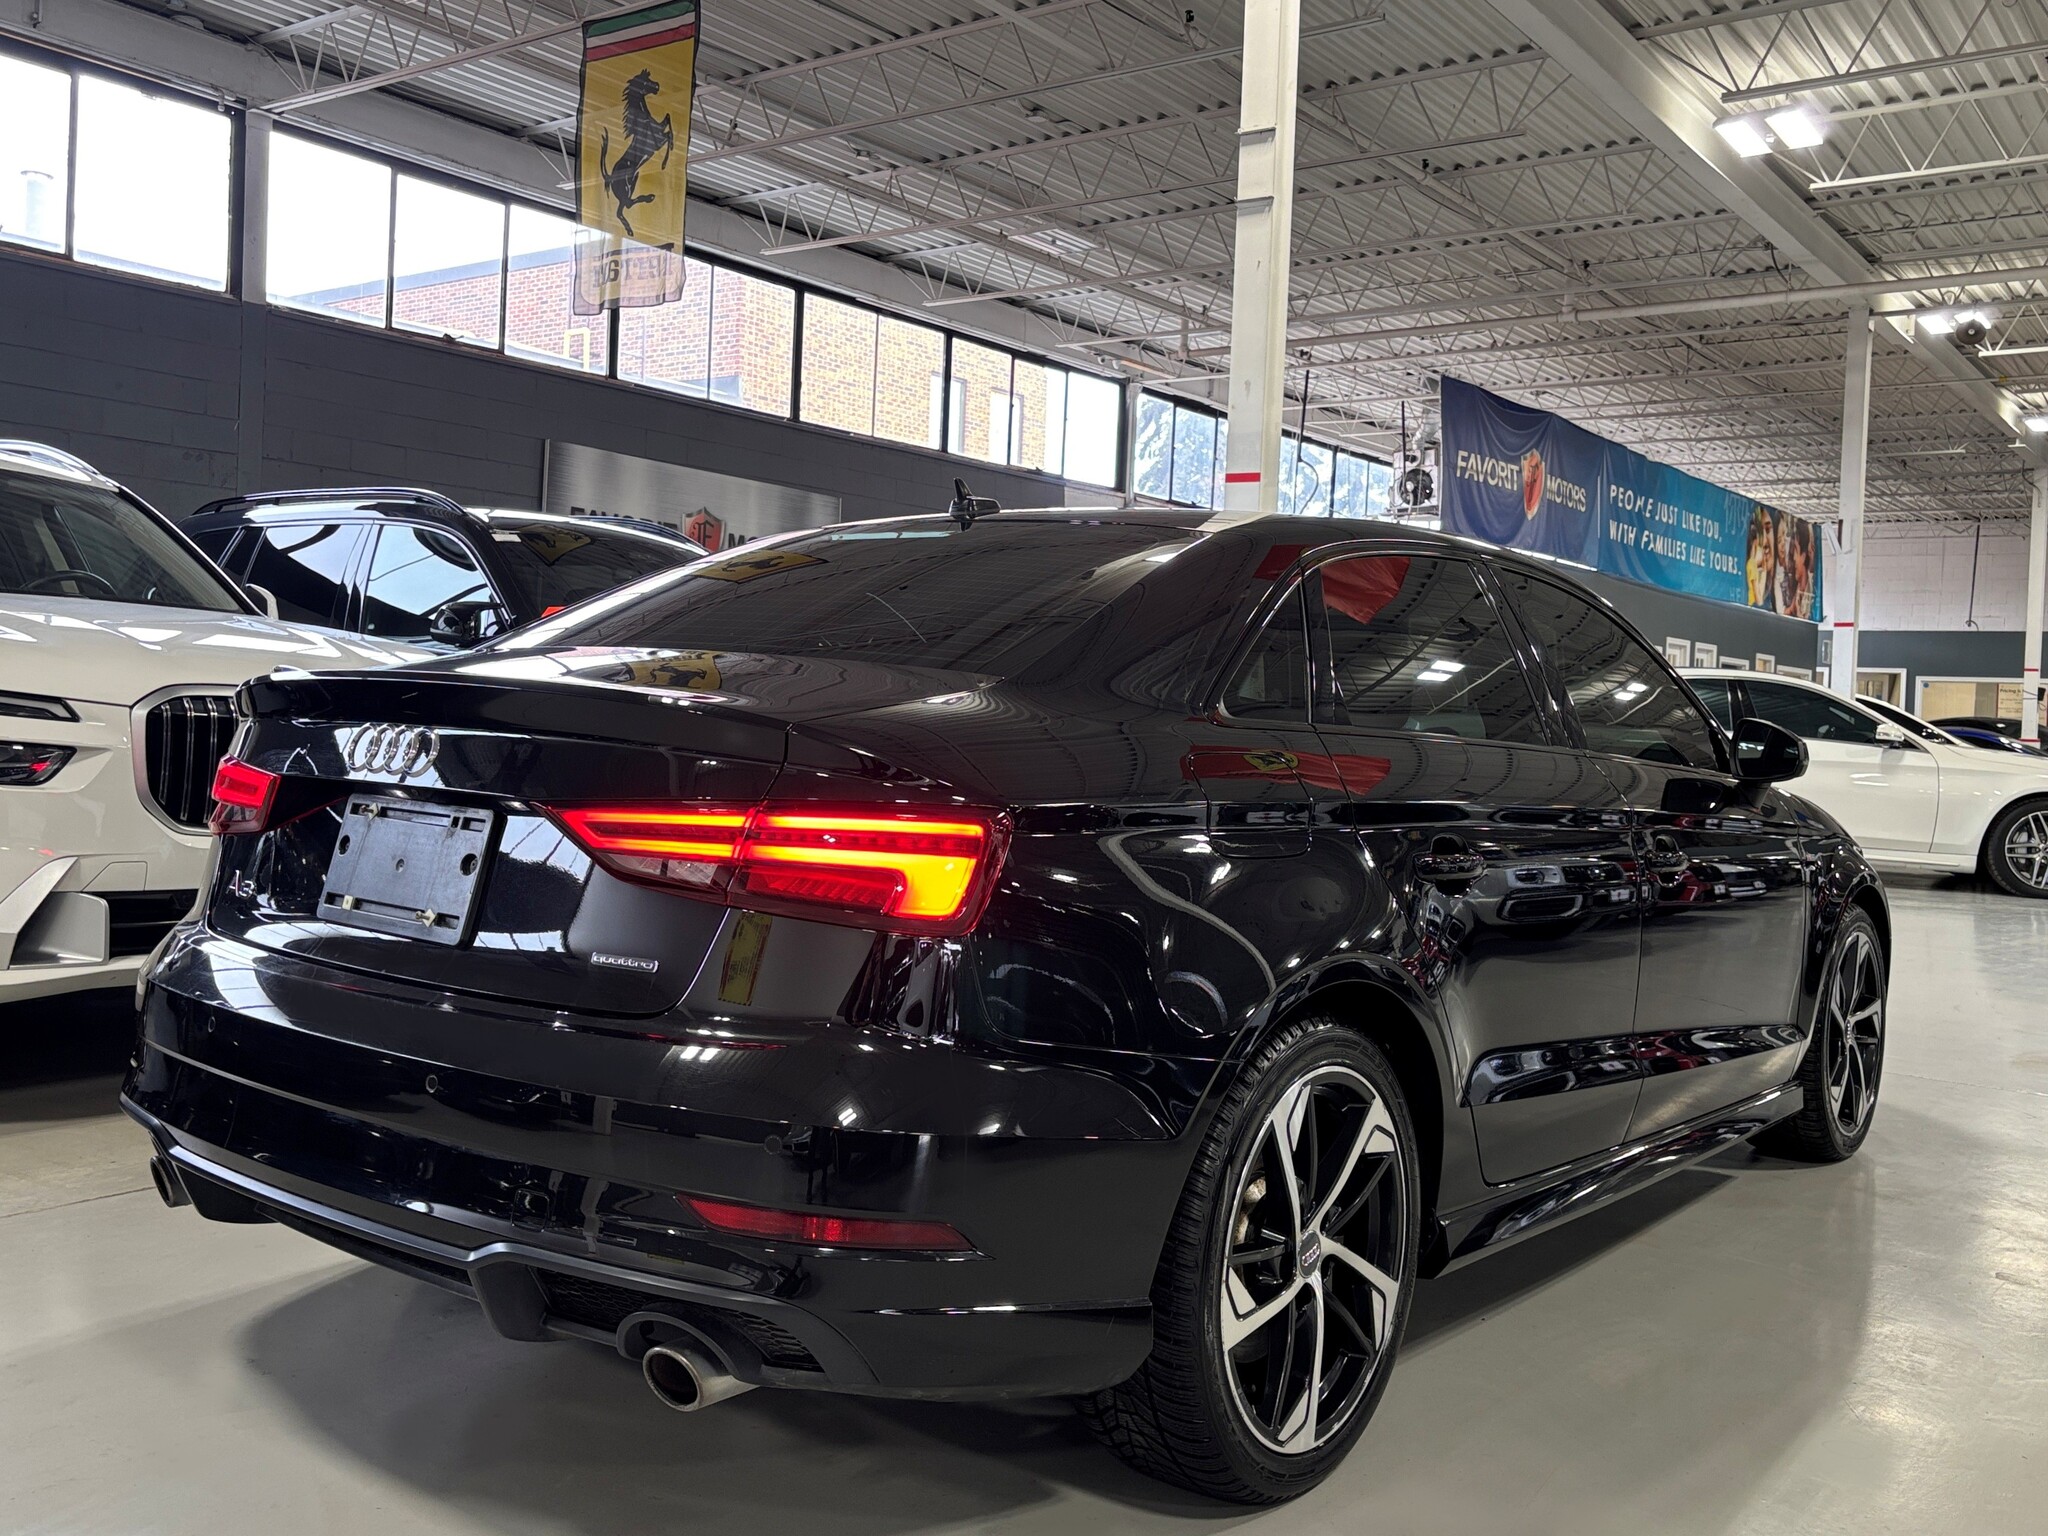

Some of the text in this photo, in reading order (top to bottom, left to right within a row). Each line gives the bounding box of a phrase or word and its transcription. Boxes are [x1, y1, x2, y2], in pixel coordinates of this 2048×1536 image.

[1456, 450, 1519, 491] FAVORIT
[1546, 474, 1586, 512] MOTORS
[1655, 502, 1678, 526] JUST
[1682, 510, 1701, 533] LIKE
[1609, 519, 1742, 576] WITH FAMILIES LIKE YOURS.
[226, 869, 256, 898] A3
[593, 955, 654, 970] quattro
